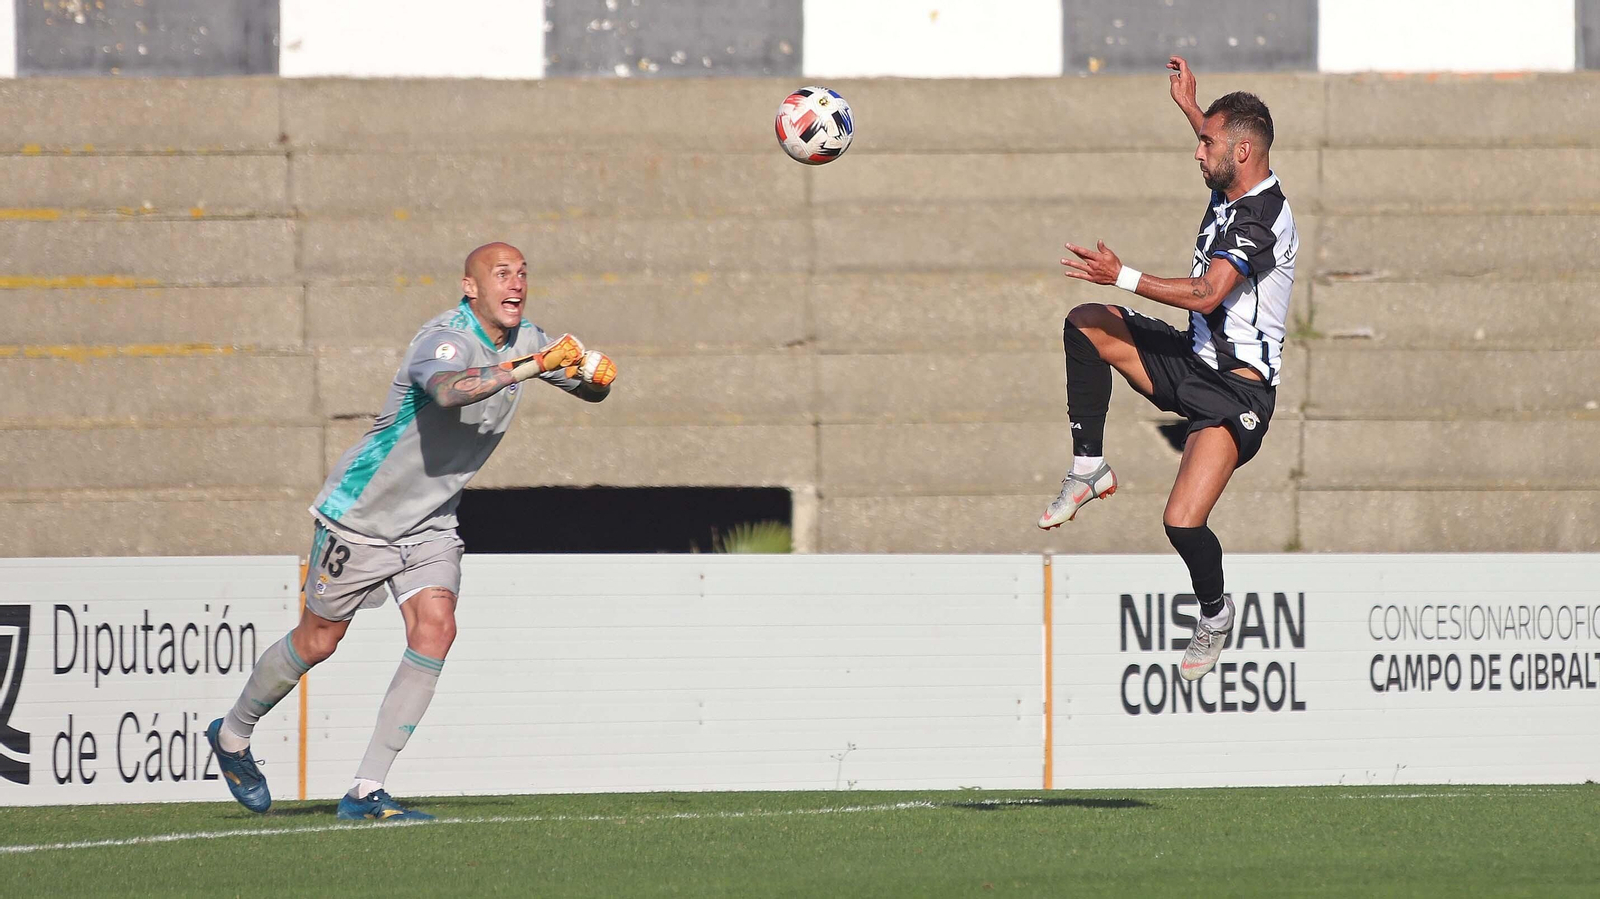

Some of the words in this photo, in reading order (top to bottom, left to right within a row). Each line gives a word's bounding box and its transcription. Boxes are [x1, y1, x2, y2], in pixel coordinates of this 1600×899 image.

[321, 535, 350, 578] 13
[53, 603, 257, 688] Diputación
[1120, 592, 1305, 652] NISAN
[1120, 661, 1306, 716] CONCESOL
[1369, 653, 1463, 693] CAMPO
[1470, 653, 1502, 692] DE
[52, 713, 98, 785] de
